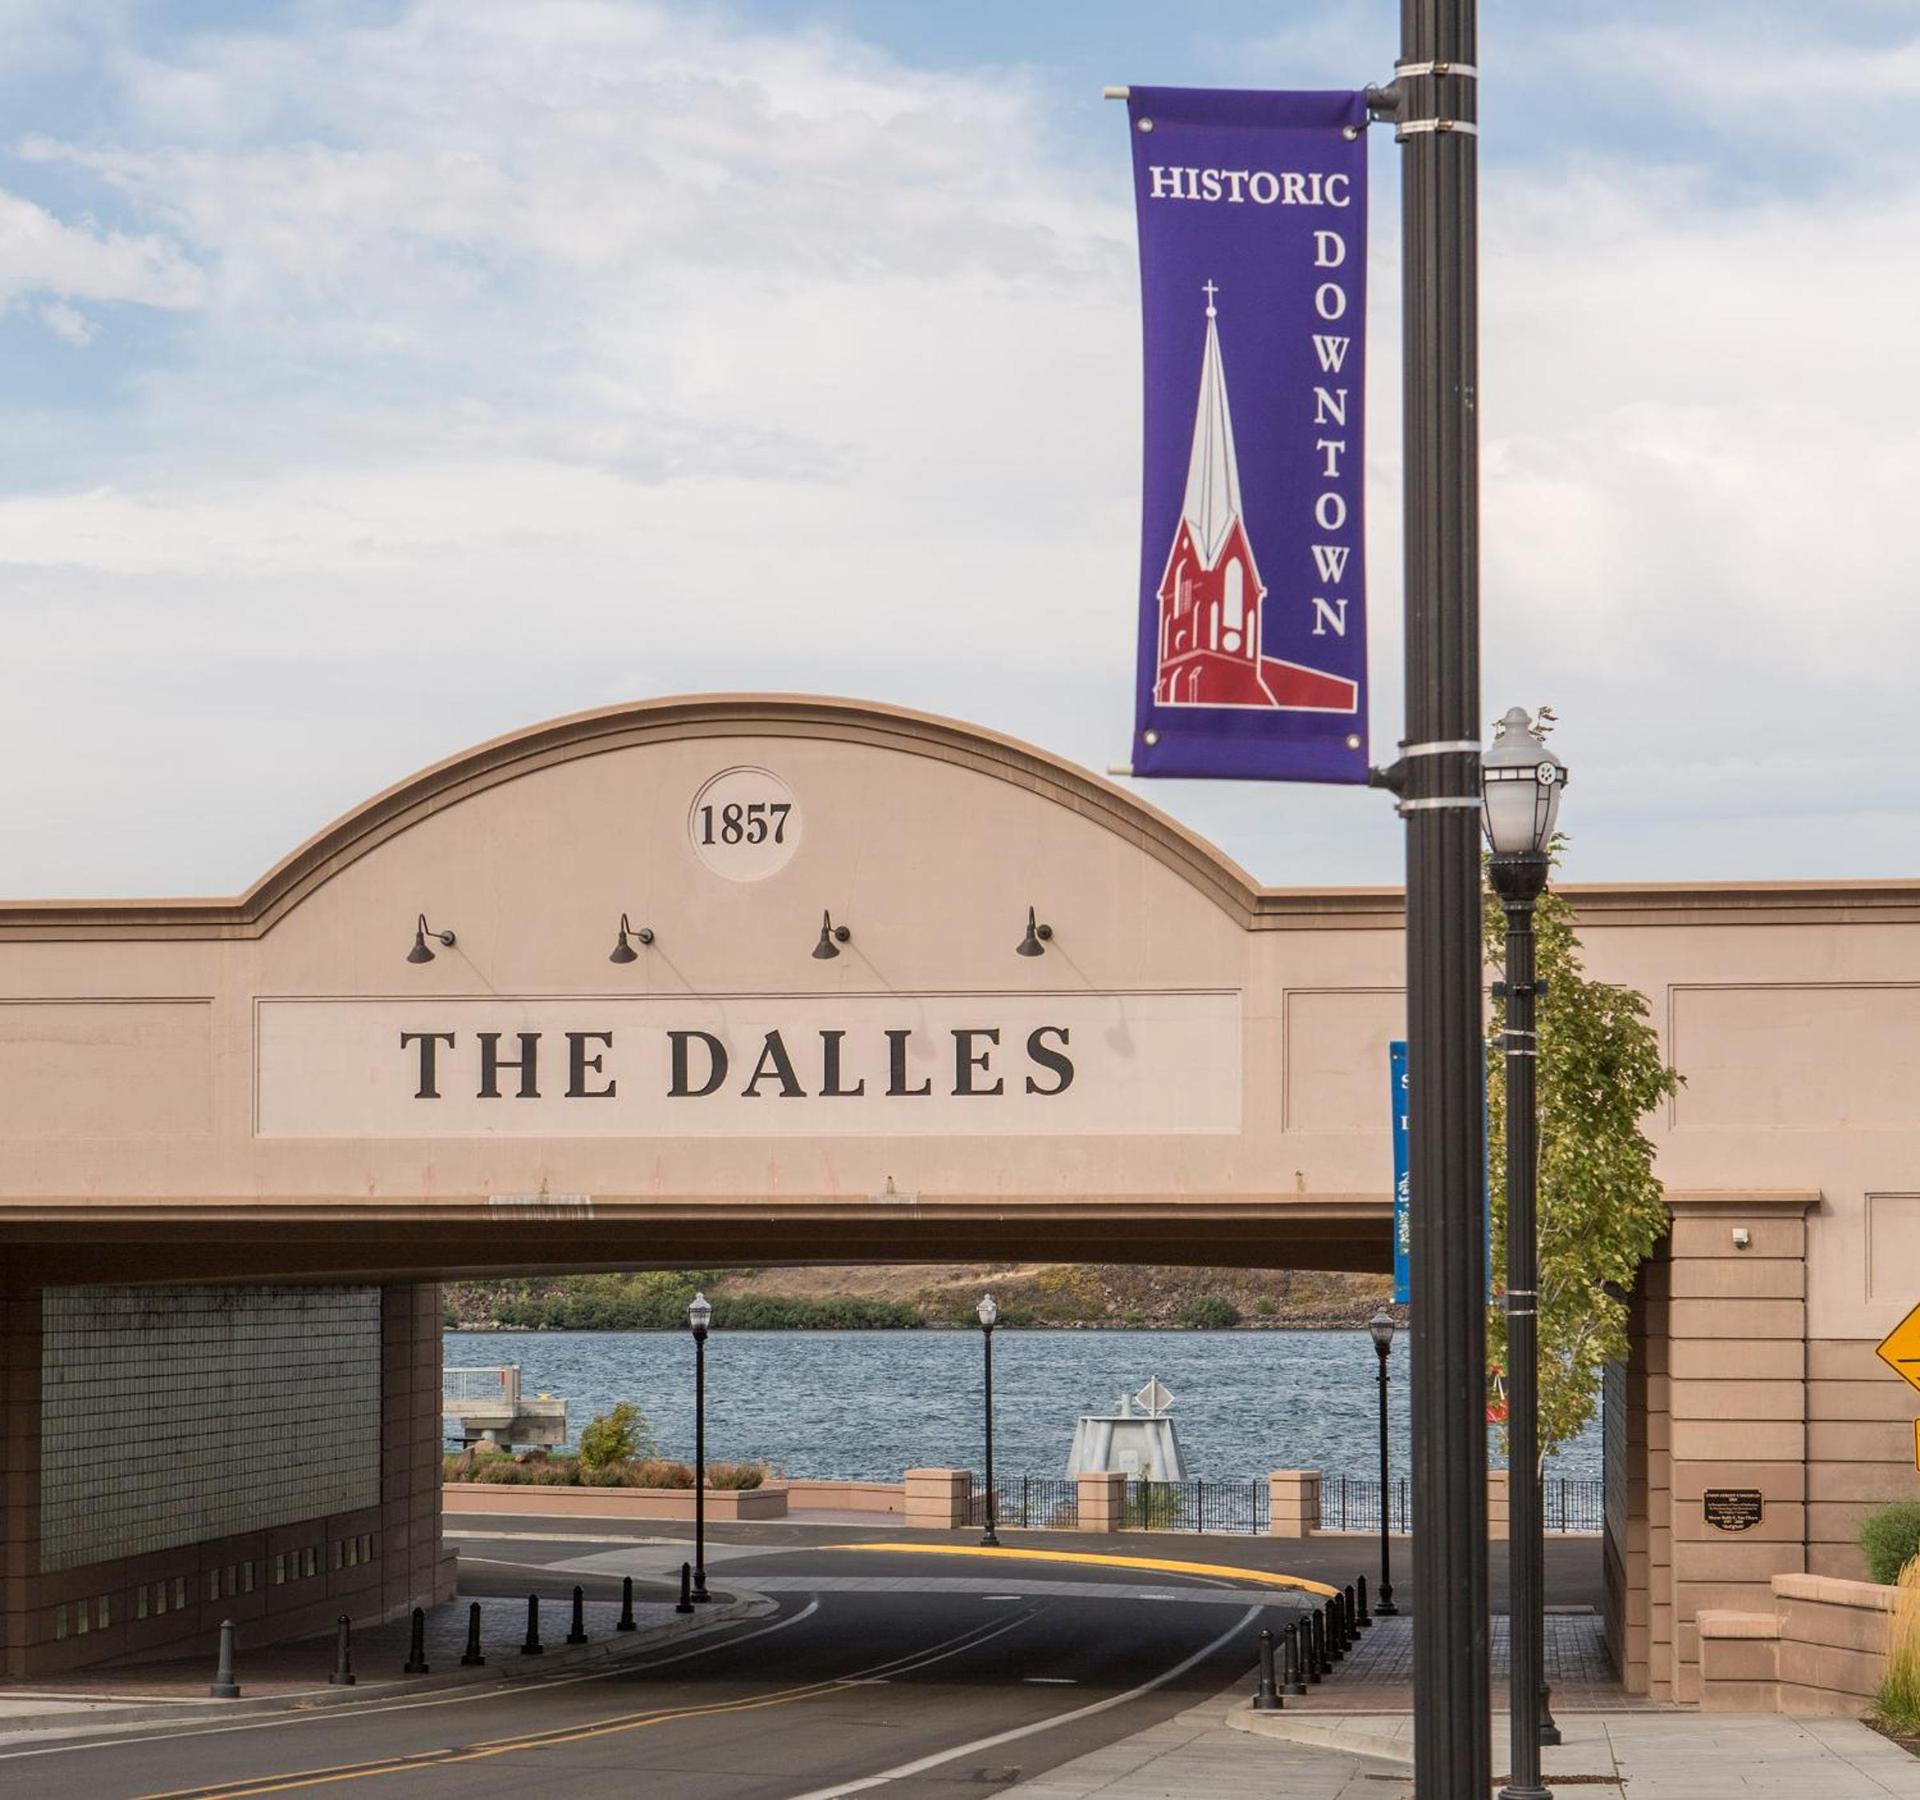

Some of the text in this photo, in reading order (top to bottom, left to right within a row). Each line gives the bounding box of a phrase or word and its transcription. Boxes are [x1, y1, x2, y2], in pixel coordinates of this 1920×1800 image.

[1149, 165, 1350, 207] HISTORIC
[1311, 229, 1350, 638] DOWNTOWN
[700, 802, 792, 845] 1857
[400, 1026, 1075, 1099] THE DALLES
